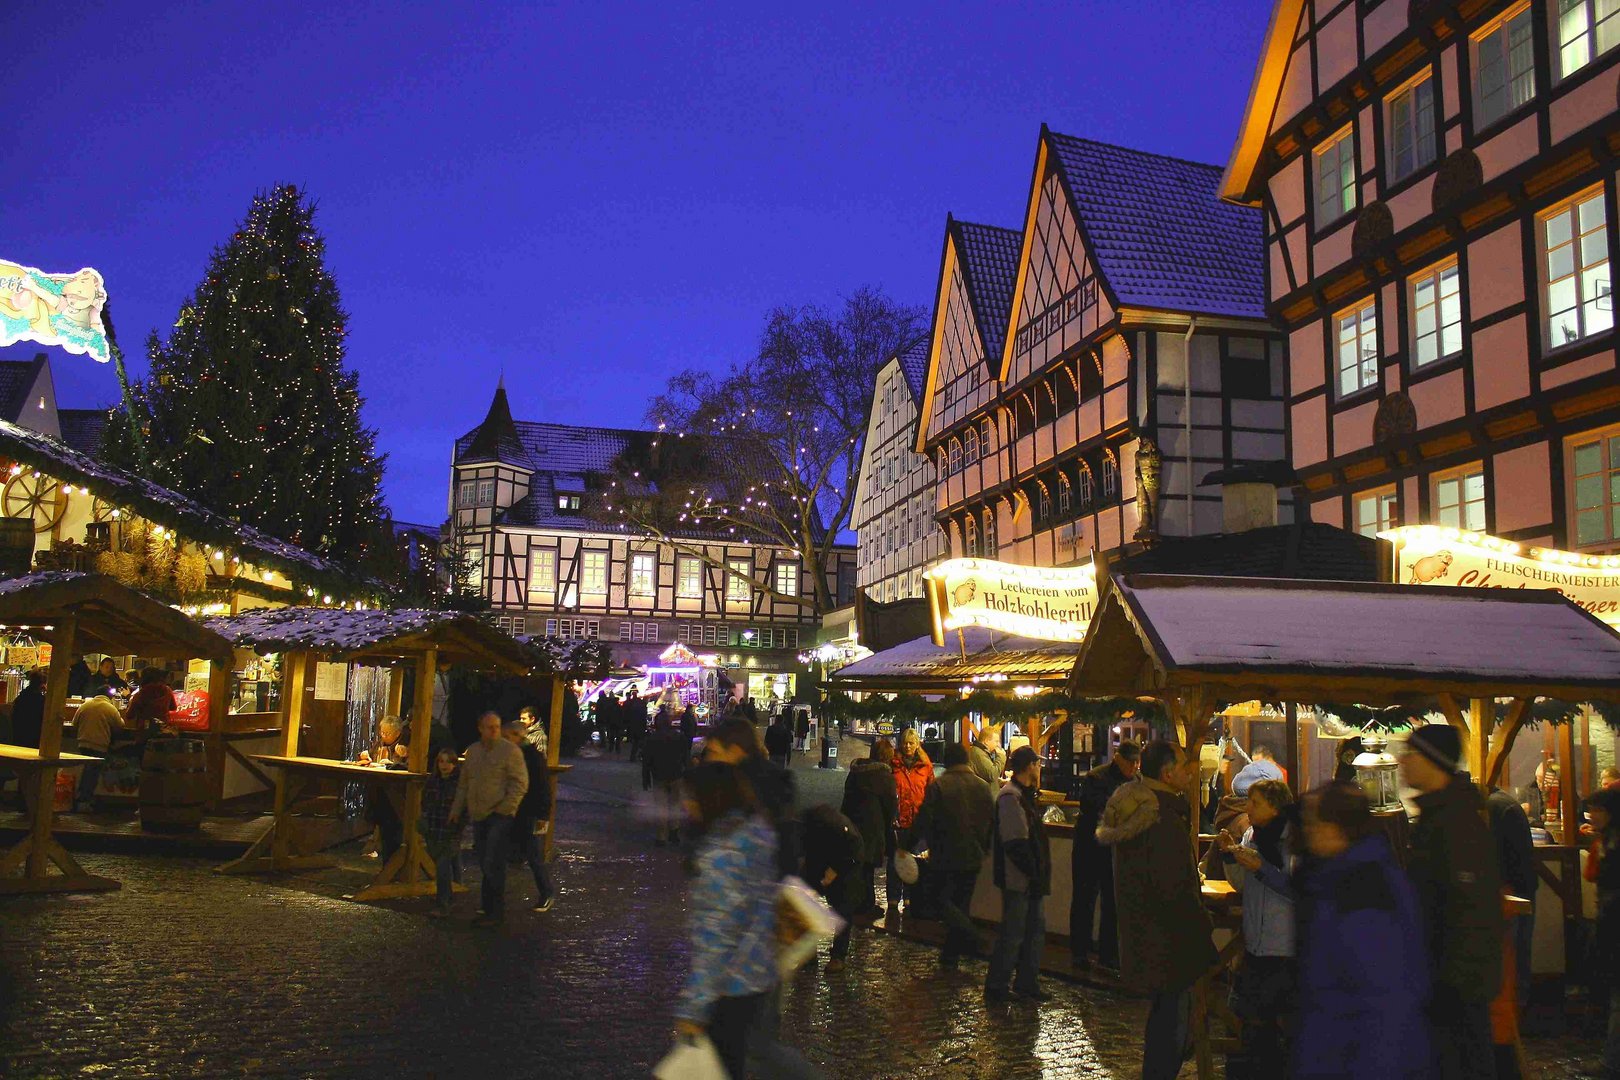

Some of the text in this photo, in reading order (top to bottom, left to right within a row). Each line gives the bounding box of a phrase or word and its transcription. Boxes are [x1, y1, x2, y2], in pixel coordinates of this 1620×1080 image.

[1000, 579, 1089, 597] Leckereien vom
[1487, 558, 1620, 588] FLEISCHERMEISTER
[984, 592, 1092, 623] Holzkohlegrill
